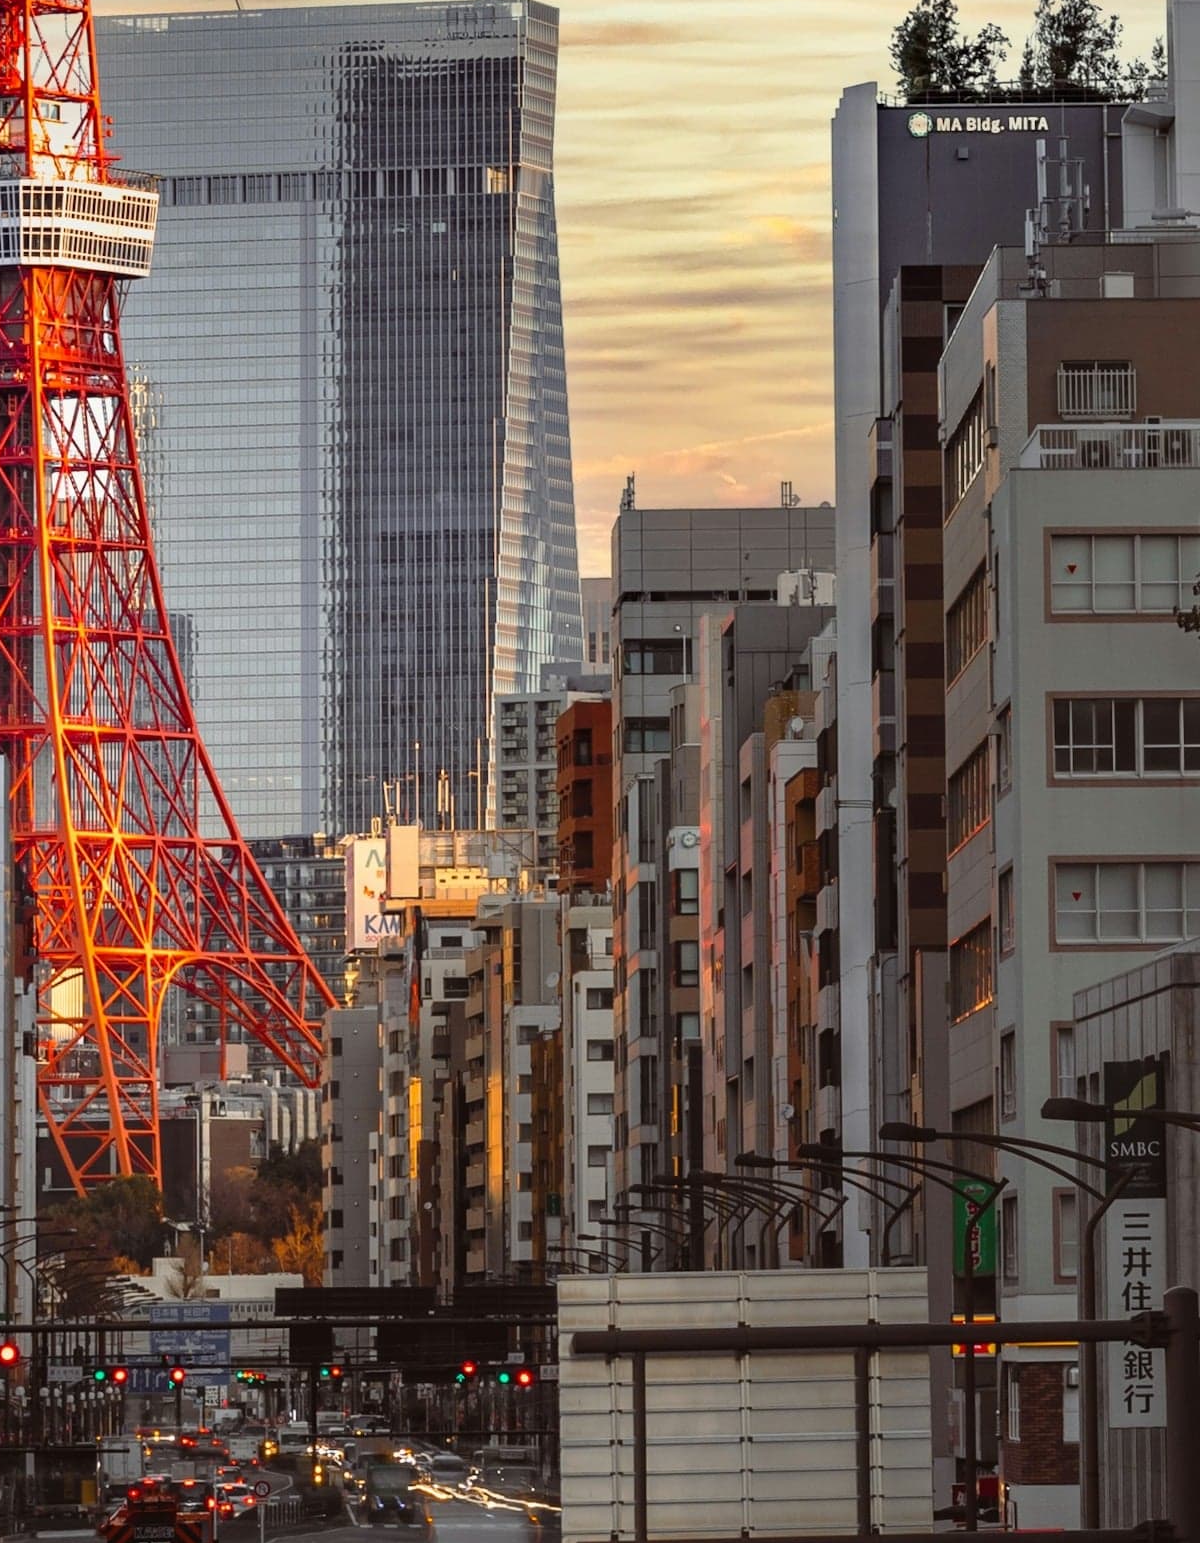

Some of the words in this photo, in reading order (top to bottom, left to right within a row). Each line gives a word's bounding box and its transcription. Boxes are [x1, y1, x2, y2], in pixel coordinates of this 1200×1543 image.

[936, 118, 962, 132] MA
[966, 116, 1005, 134] Bldg.
[1009, 116, 1049, 131] MITA
[1110, 1141, 1160, 1158] SMBC
[1121, 1212, 1154, 1414] 三井住銀行
